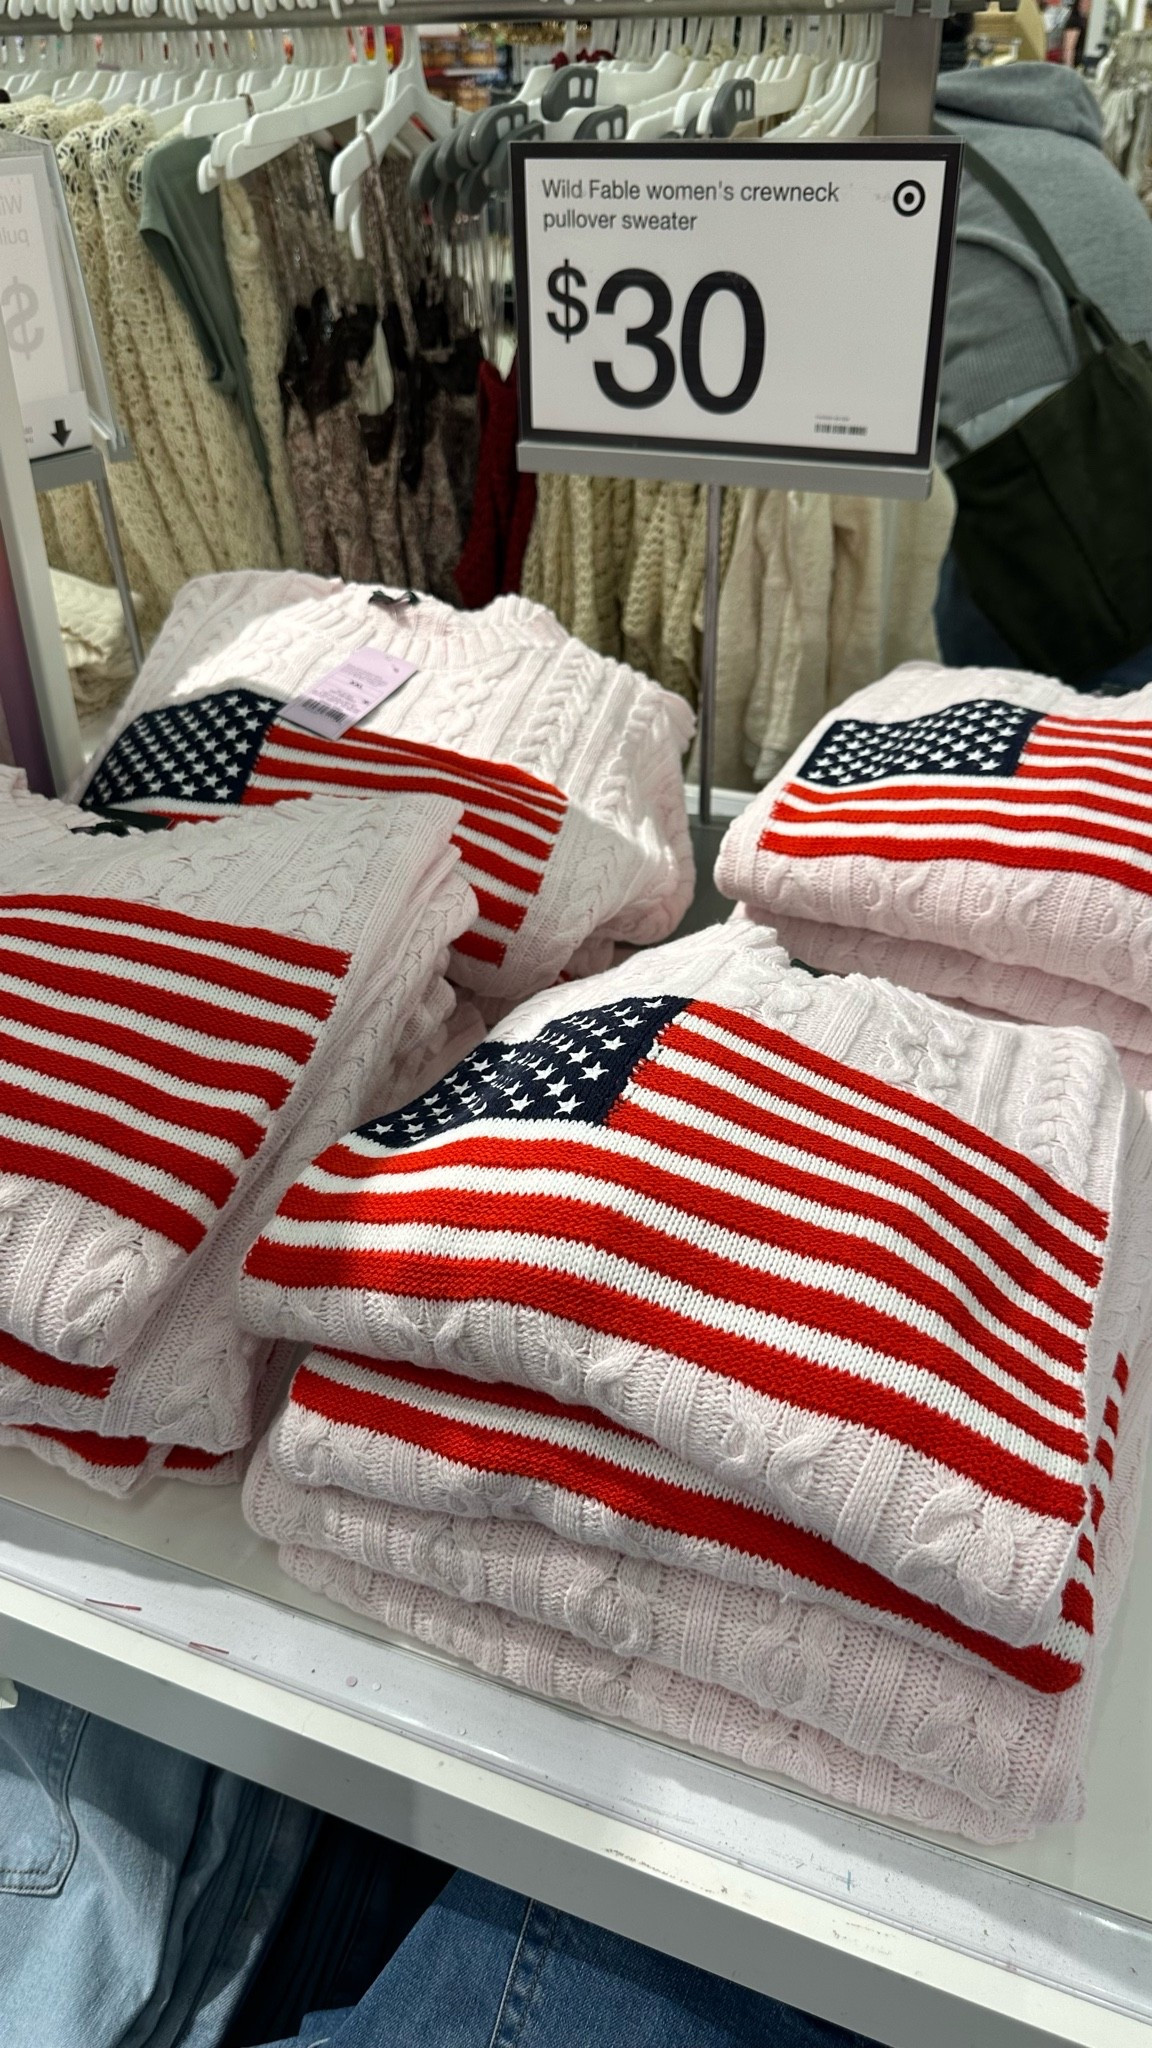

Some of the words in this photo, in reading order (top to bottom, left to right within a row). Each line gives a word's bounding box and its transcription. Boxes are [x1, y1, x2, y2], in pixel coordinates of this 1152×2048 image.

[541, 178, 583, 200] Wild
[589, 179, 641, 200] Fable
[645, 180, 735, 202] women's
[740, 181, 840, 203] crewneck
[543, 209, 617, 232] pullover
[621, 211, 698, 231] sweater
[545, 257, 767, 416] $30
